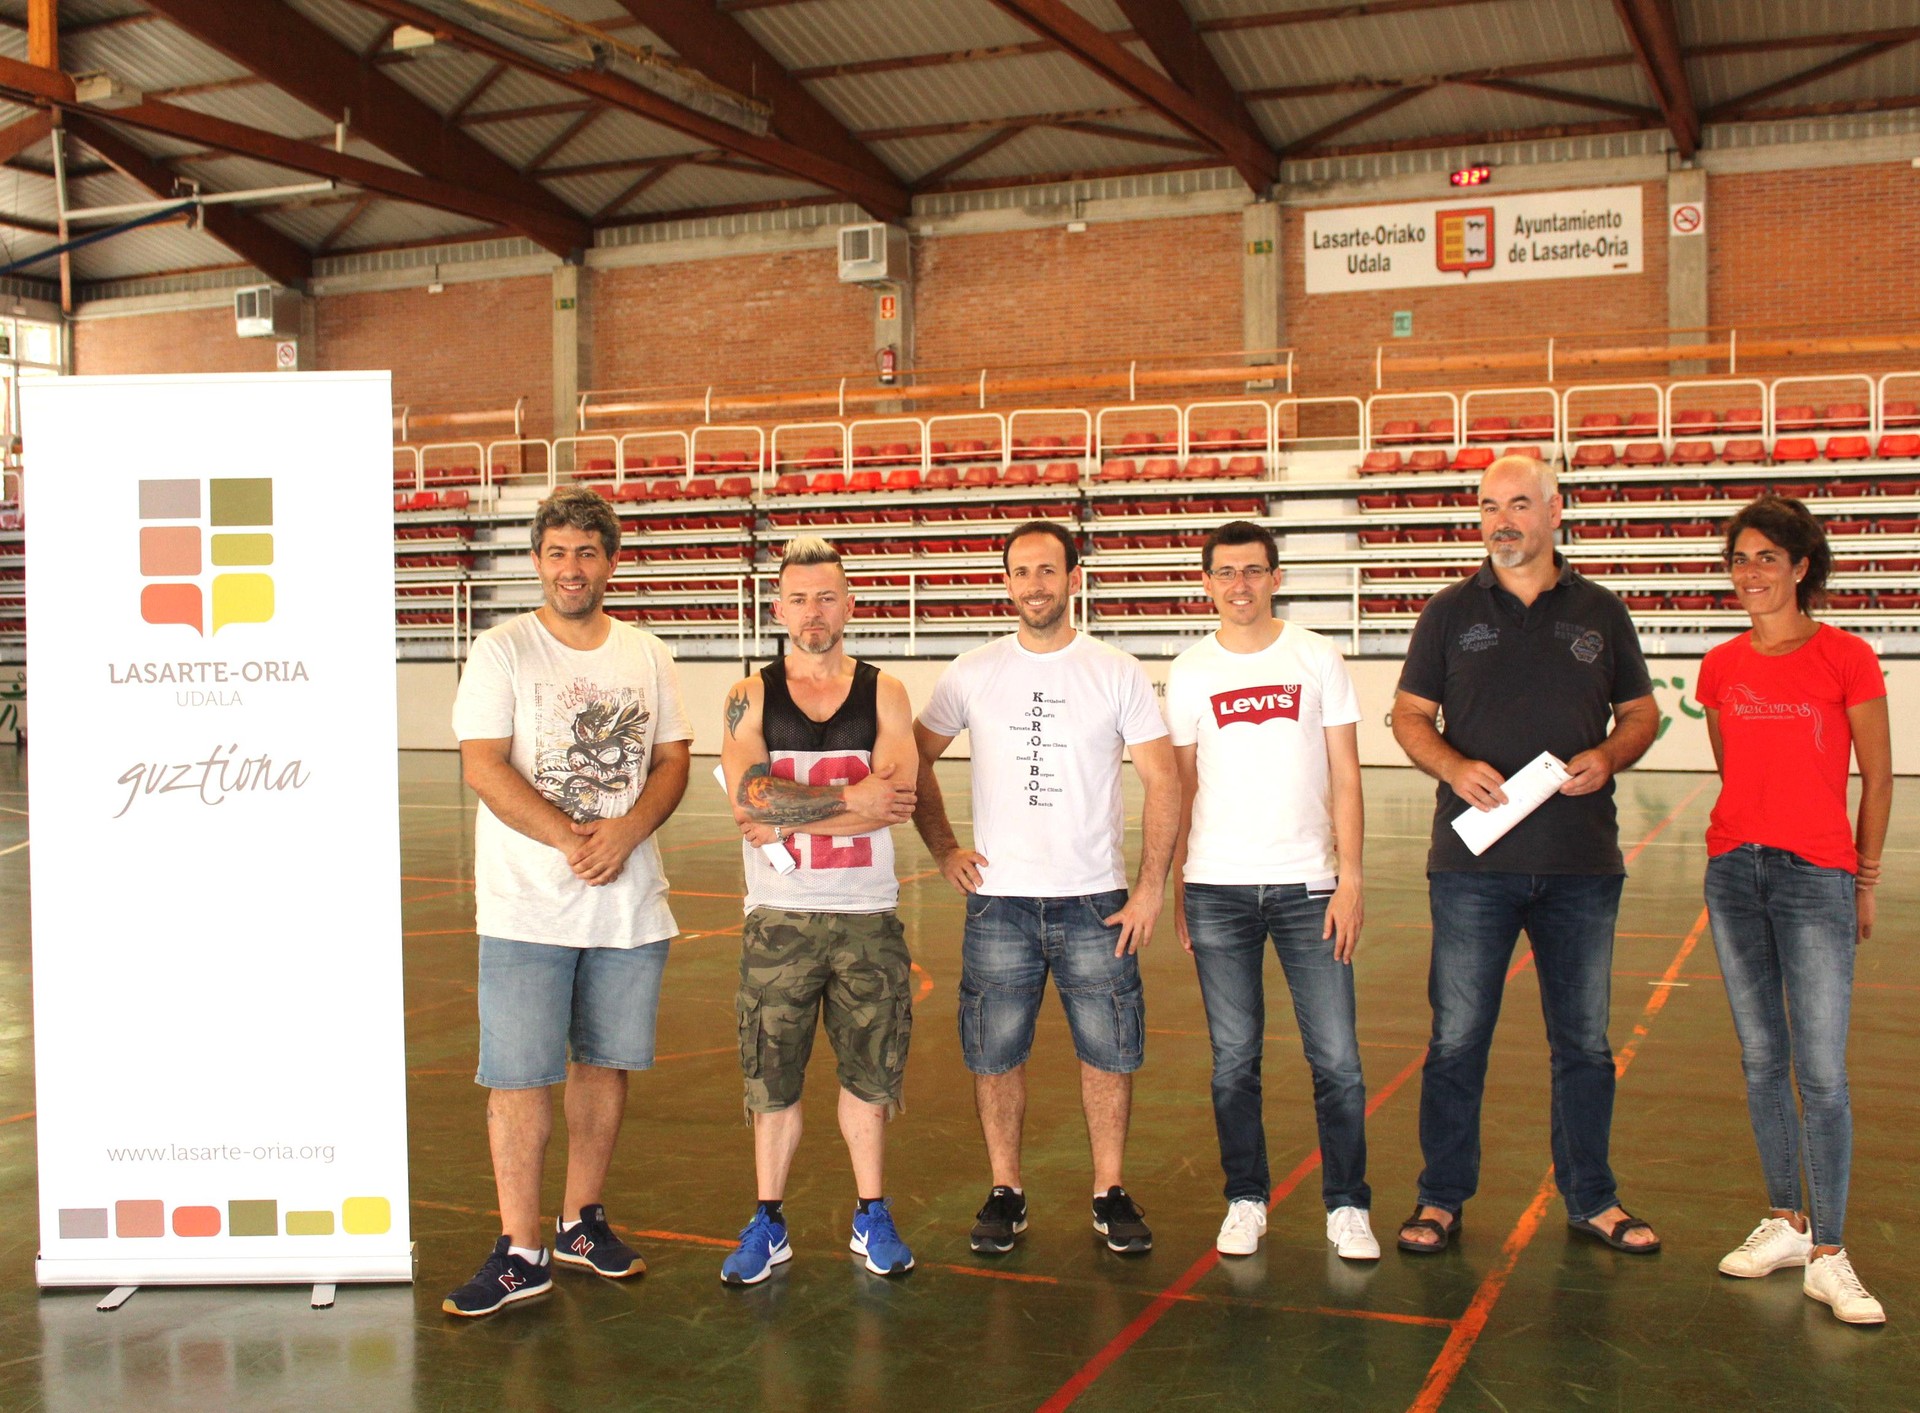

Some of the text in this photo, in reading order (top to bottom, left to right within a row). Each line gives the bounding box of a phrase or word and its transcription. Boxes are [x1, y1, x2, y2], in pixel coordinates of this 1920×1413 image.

[1514, 208, 1621, 235] Ayuntamiento
[1313, 224, 1426, 250] Lasarte-Oriako
[1508, 235, 1629, 263] de Lasarte-Oria
[1347, 253, 1391, 275] Udala
[108, 661, 310, 684] LASARTE-ORIA
[175, 690, 243, 707] UDALA
[112, 743, 311, 819] guztiona
[106, 1143, 336, 1163] www.lasarte-oria.org
